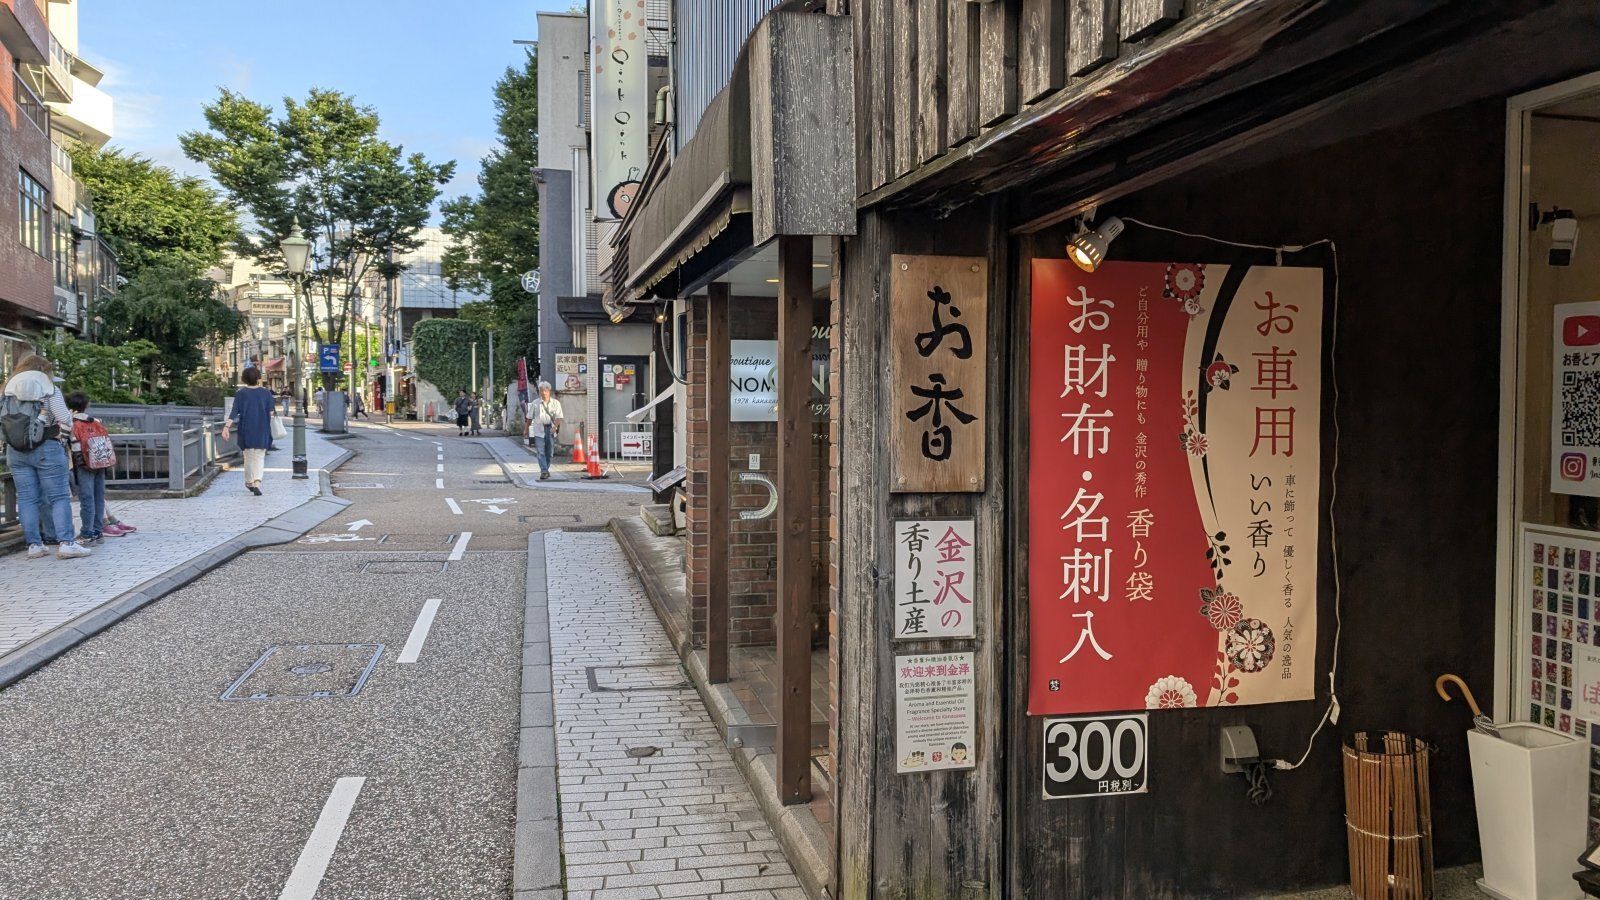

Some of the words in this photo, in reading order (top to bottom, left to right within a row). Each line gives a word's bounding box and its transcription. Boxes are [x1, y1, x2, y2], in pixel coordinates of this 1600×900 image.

[1136, 286, 1149, 350] ご自分用や
[906, 286, 978, 461] お香
[1136, 358, 1148, 424] 贈り物にも
[1248, 291, 1298, 458] お車用
[1060, 286, 1116, 664] お財布・名刺入
[1134, 432, 1148, 498] 金沢の秀作
[1247, 474, 1272, 578] いい香り
[1284, 474, 1296, 537] 車に飾って
[899, 522, 930, 635] 香り土産
[932, 526, 972, 628] 金沢の
[1126, 508, 1154, 602] 香り袋
[1282, 544, 1294, 608] 優しく香る
[900, 663, 970, 678] 欢迎来到金泽
[1282, 616, 1294, 680] 人気の逸品
[1046, 719, 1144, 782] 300
